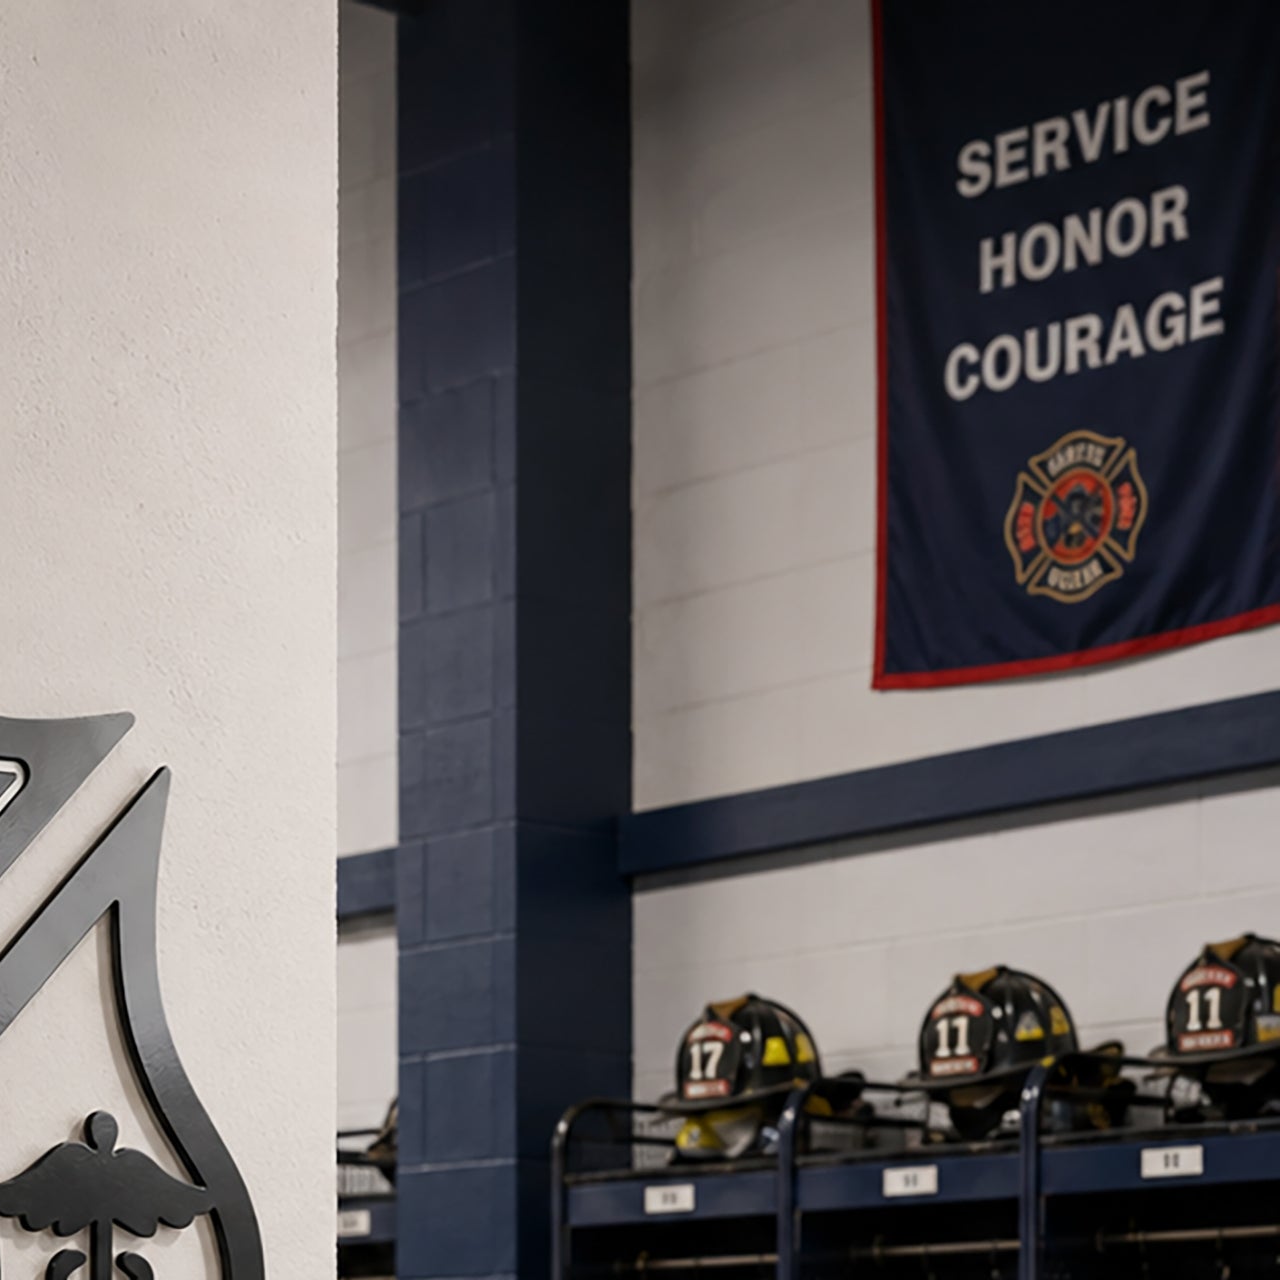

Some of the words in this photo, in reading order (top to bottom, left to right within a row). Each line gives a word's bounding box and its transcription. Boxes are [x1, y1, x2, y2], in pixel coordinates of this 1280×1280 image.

[956, 69, 1211, 198] SERVICE
[979, 184, 1189, 294] HONOR
[944, 275, 1225, 401] COURAGE
[935, 1015, 971, 1057] 11
[1185, 986, 1223, 1032] 11
[689, 1040, 725, 1080] 17
